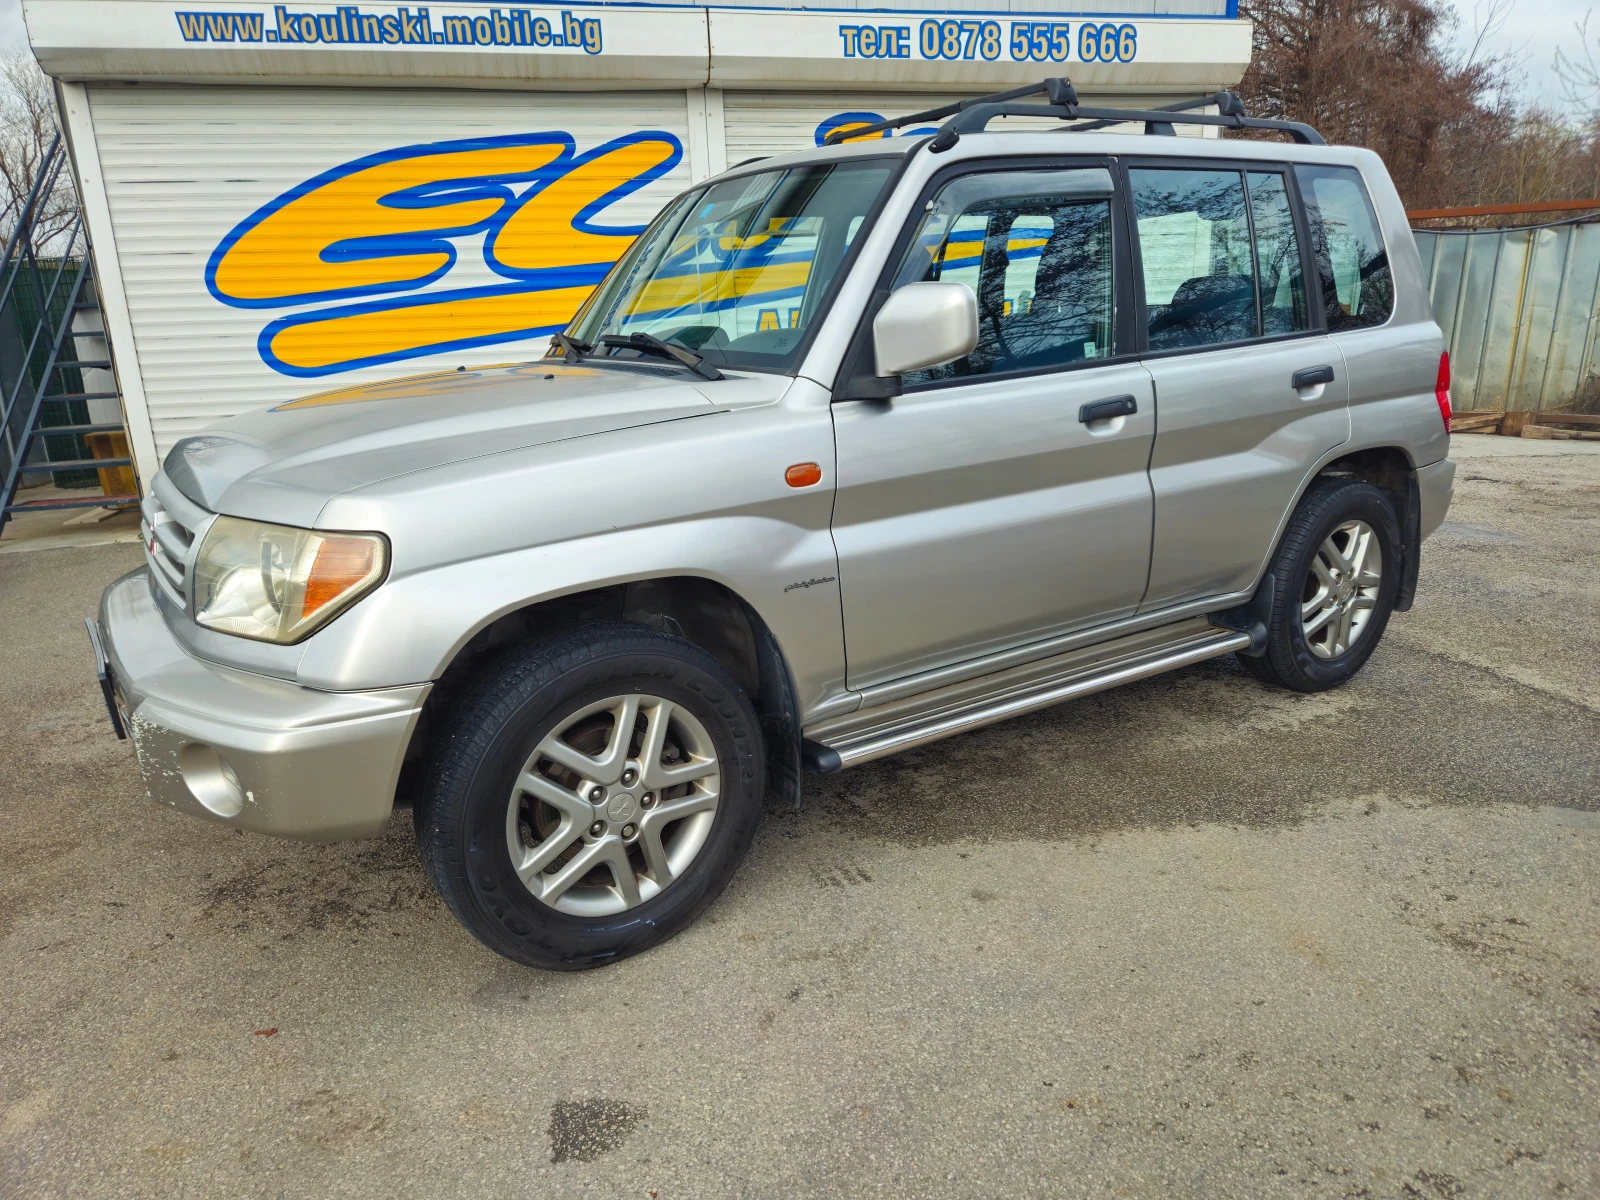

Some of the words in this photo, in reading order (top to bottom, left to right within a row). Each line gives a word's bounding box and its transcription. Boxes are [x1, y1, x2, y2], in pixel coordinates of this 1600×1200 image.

[175, 5, 603, 55] www.koulinski.mobile.bg
[839, 25, 910, 58] тел:
[919, 19, 1001, 61] 0878
[1010, 22, 1069, 62] 555
[1078, 23, 1137, 63] 666
